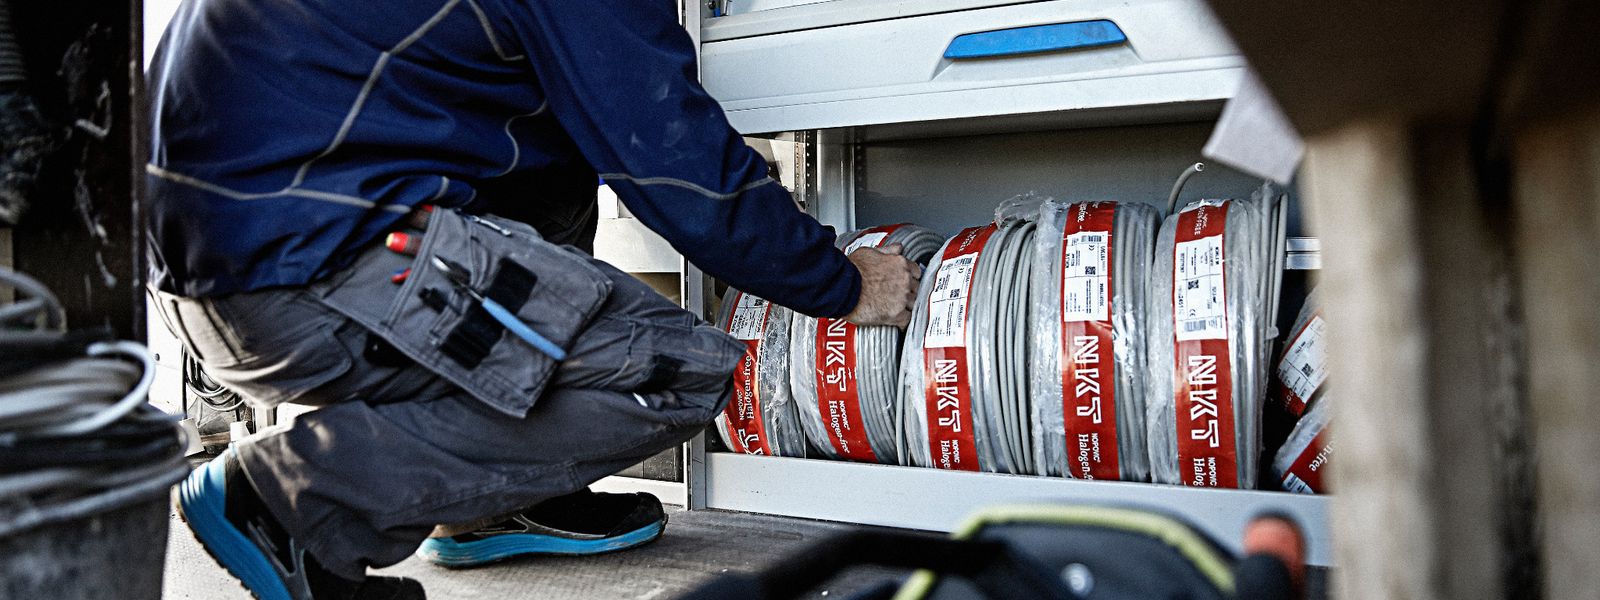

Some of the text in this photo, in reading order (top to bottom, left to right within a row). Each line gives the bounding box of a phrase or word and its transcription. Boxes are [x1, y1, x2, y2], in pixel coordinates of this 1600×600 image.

[743, 355, 754, 420] Halogen-free
[826, 319, 847, 391] NKT
[1074, 335, 1102, 424] NKT
[829, 400, 850, 453] Halogen-free
[935, 360, 961, 432] NKT
[1189, 355, 1219, 447] NKT
[1207, 457, 1217, 486] NOPOVIC
